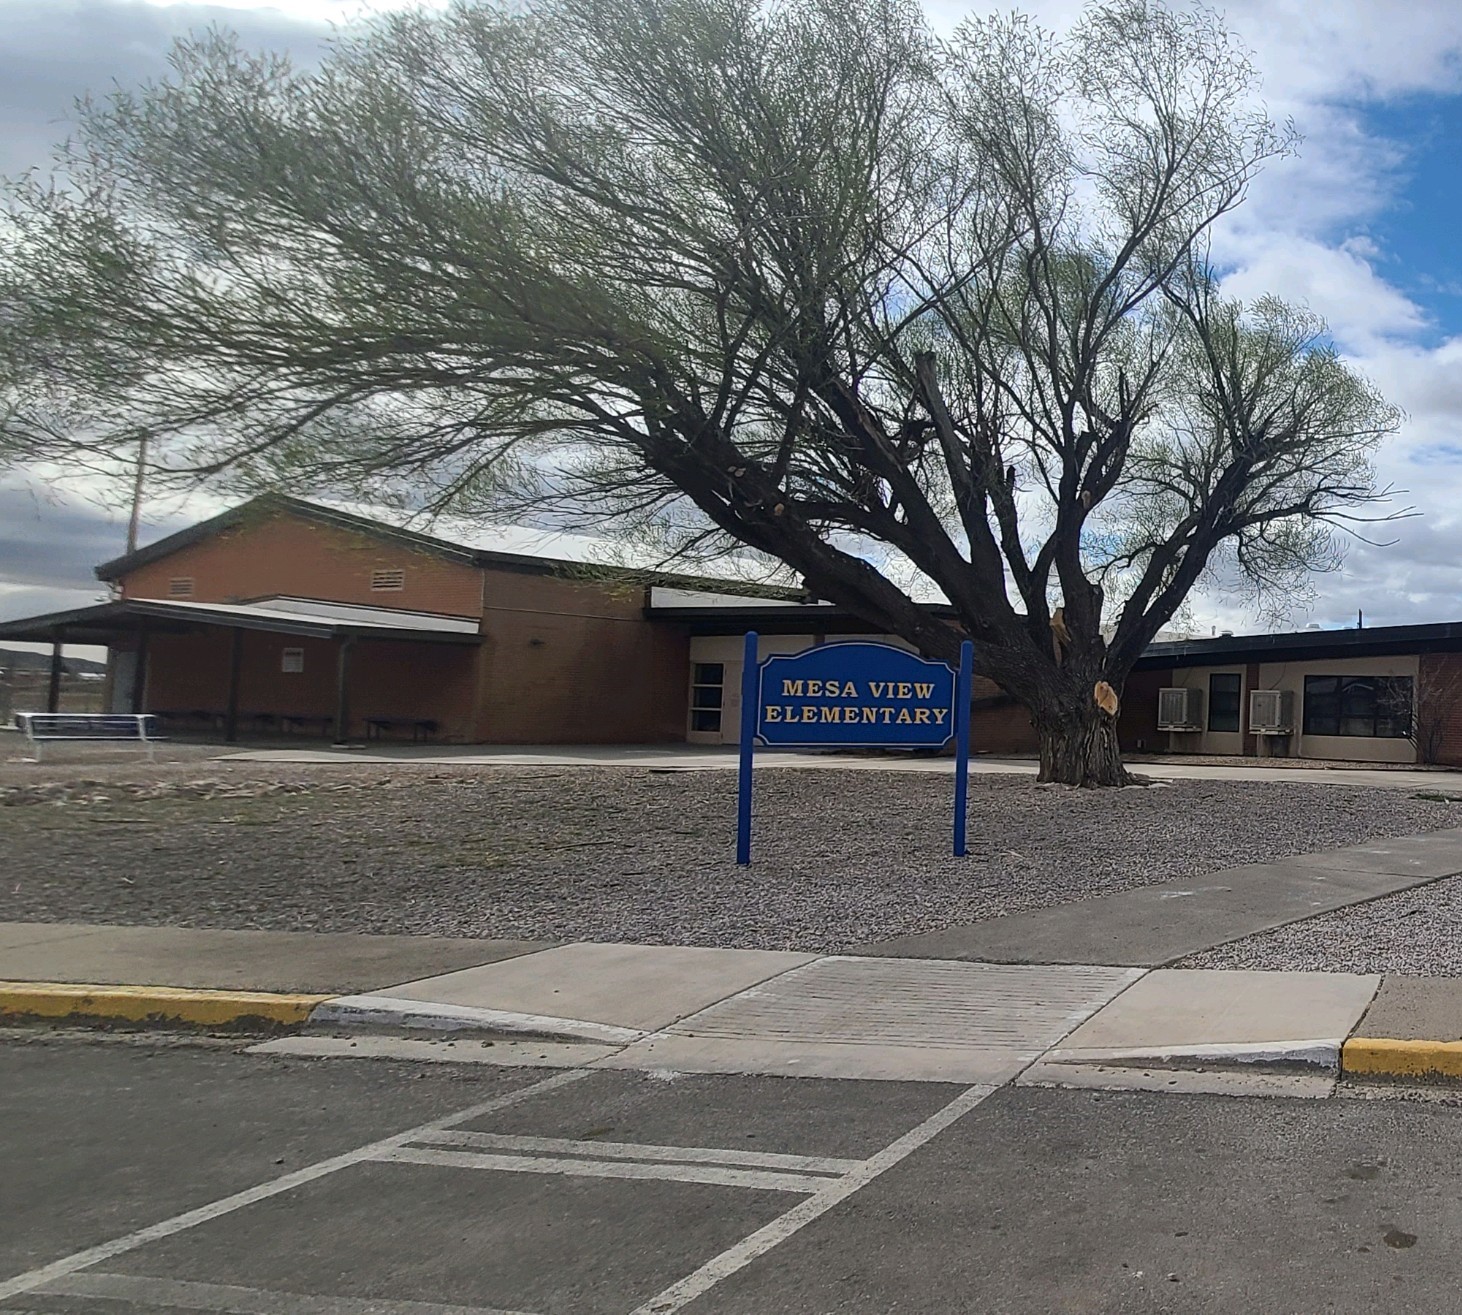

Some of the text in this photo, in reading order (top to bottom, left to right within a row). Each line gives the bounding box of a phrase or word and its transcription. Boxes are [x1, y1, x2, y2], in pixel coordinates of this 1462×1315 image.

[782, 679, 935, 699] MESA VIEW
[764, 705, 948, 725] ELEMENTARY
